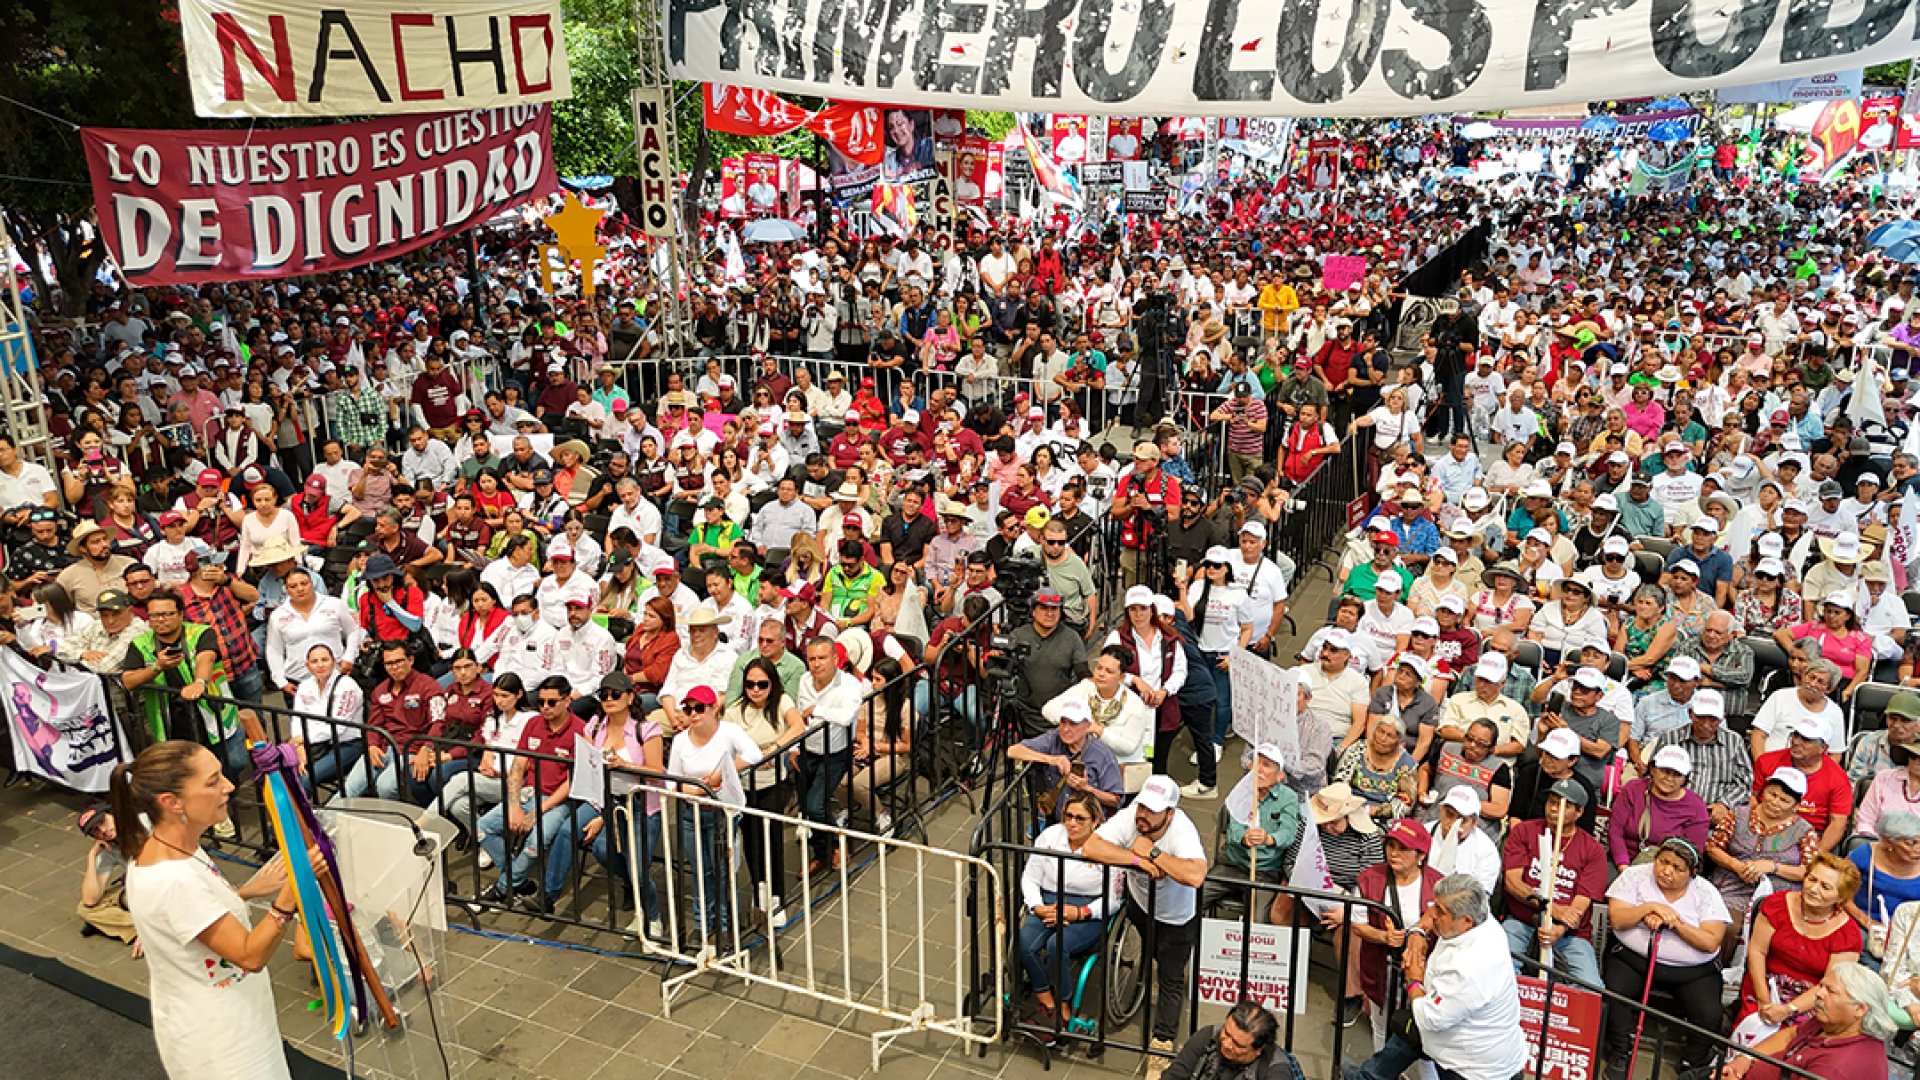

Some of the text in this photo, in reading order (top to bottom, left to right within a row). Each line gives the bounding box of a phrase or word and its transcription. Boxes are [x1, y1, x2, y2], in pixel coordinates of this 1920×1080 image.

[210, 10, 554, 103] NACHO
[1524, 0, 1920, 92] POB
[1249, 117, 1276, 134] CHO
[105, 143, 162, 186] LO
[187, 135, 361, 185] NUESTRO
[371, 128, 407, 170] ES
[640, 102, 667, 228] NACHO
[111, 130, 542, 272] DE DIGNIDAD
[933, 160, 953, 251] NACHO
[539, 245, 607, 296] PT
[1225, 932, 1276, 946] morna
[1198, 975, 1289, 995] HEINAUM
[1200, 986, 1289, 1010] CLADIA
